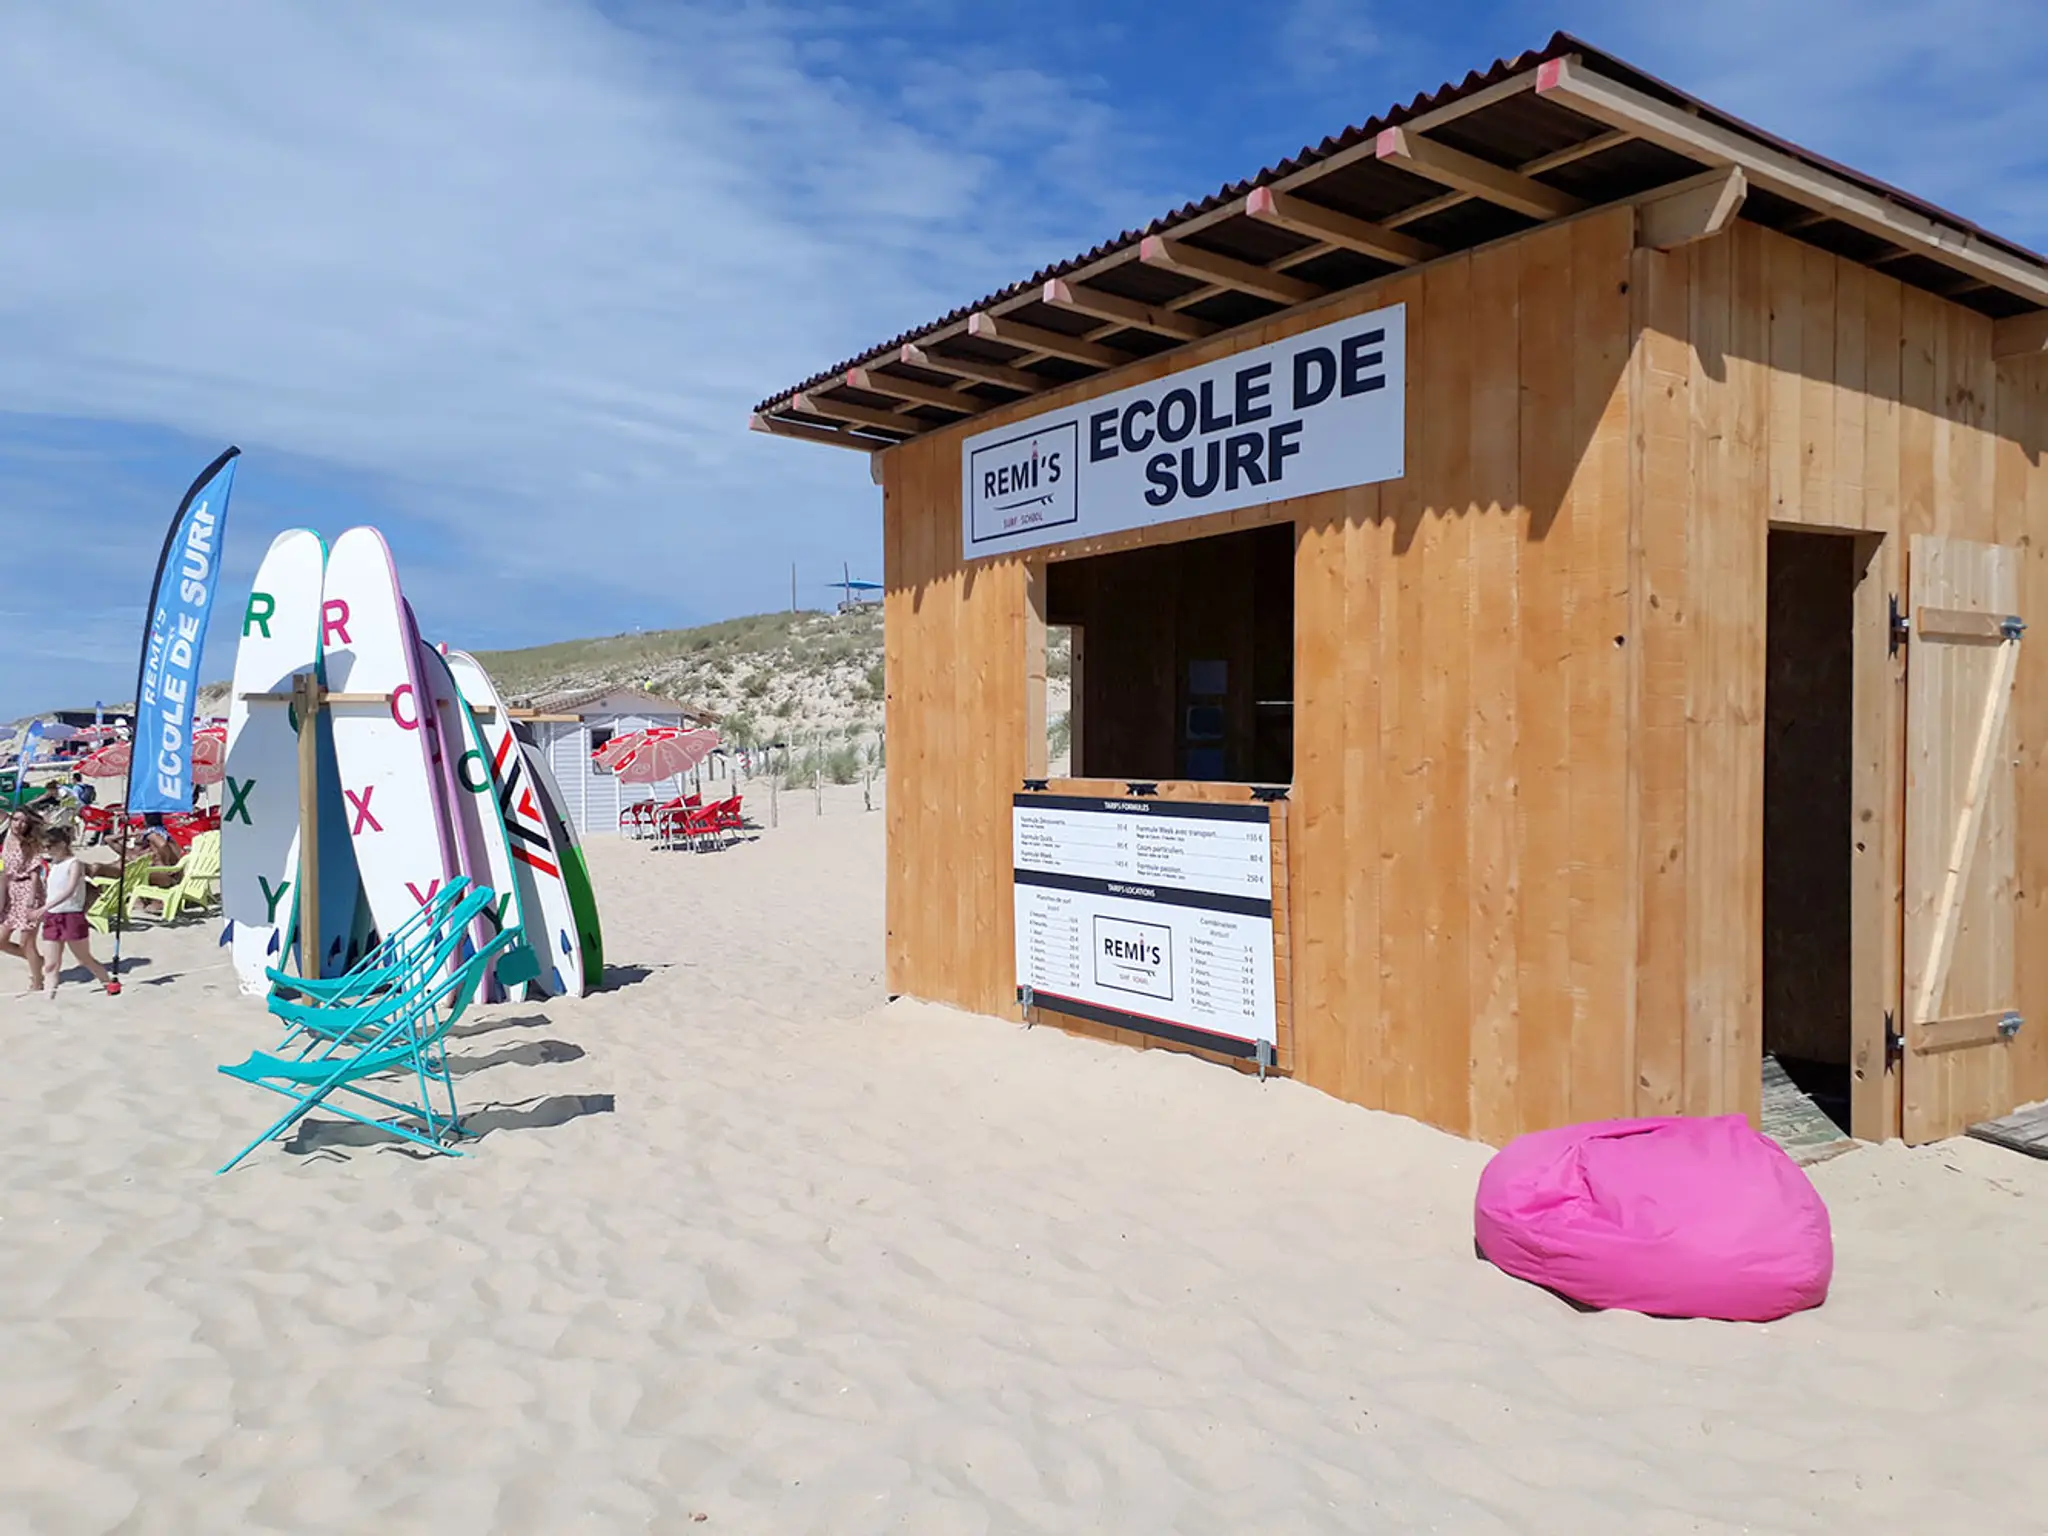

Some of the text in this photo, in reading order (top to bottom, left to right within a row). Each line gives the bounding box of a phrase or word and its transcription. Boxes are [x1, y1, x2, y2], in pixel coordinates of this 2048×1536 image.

[1089, 327, 1386, 463] ECOLE DE
[1144, 419, 1304, 507] SURF
[157, 500, 215, 800] ECOLE DE SURF
